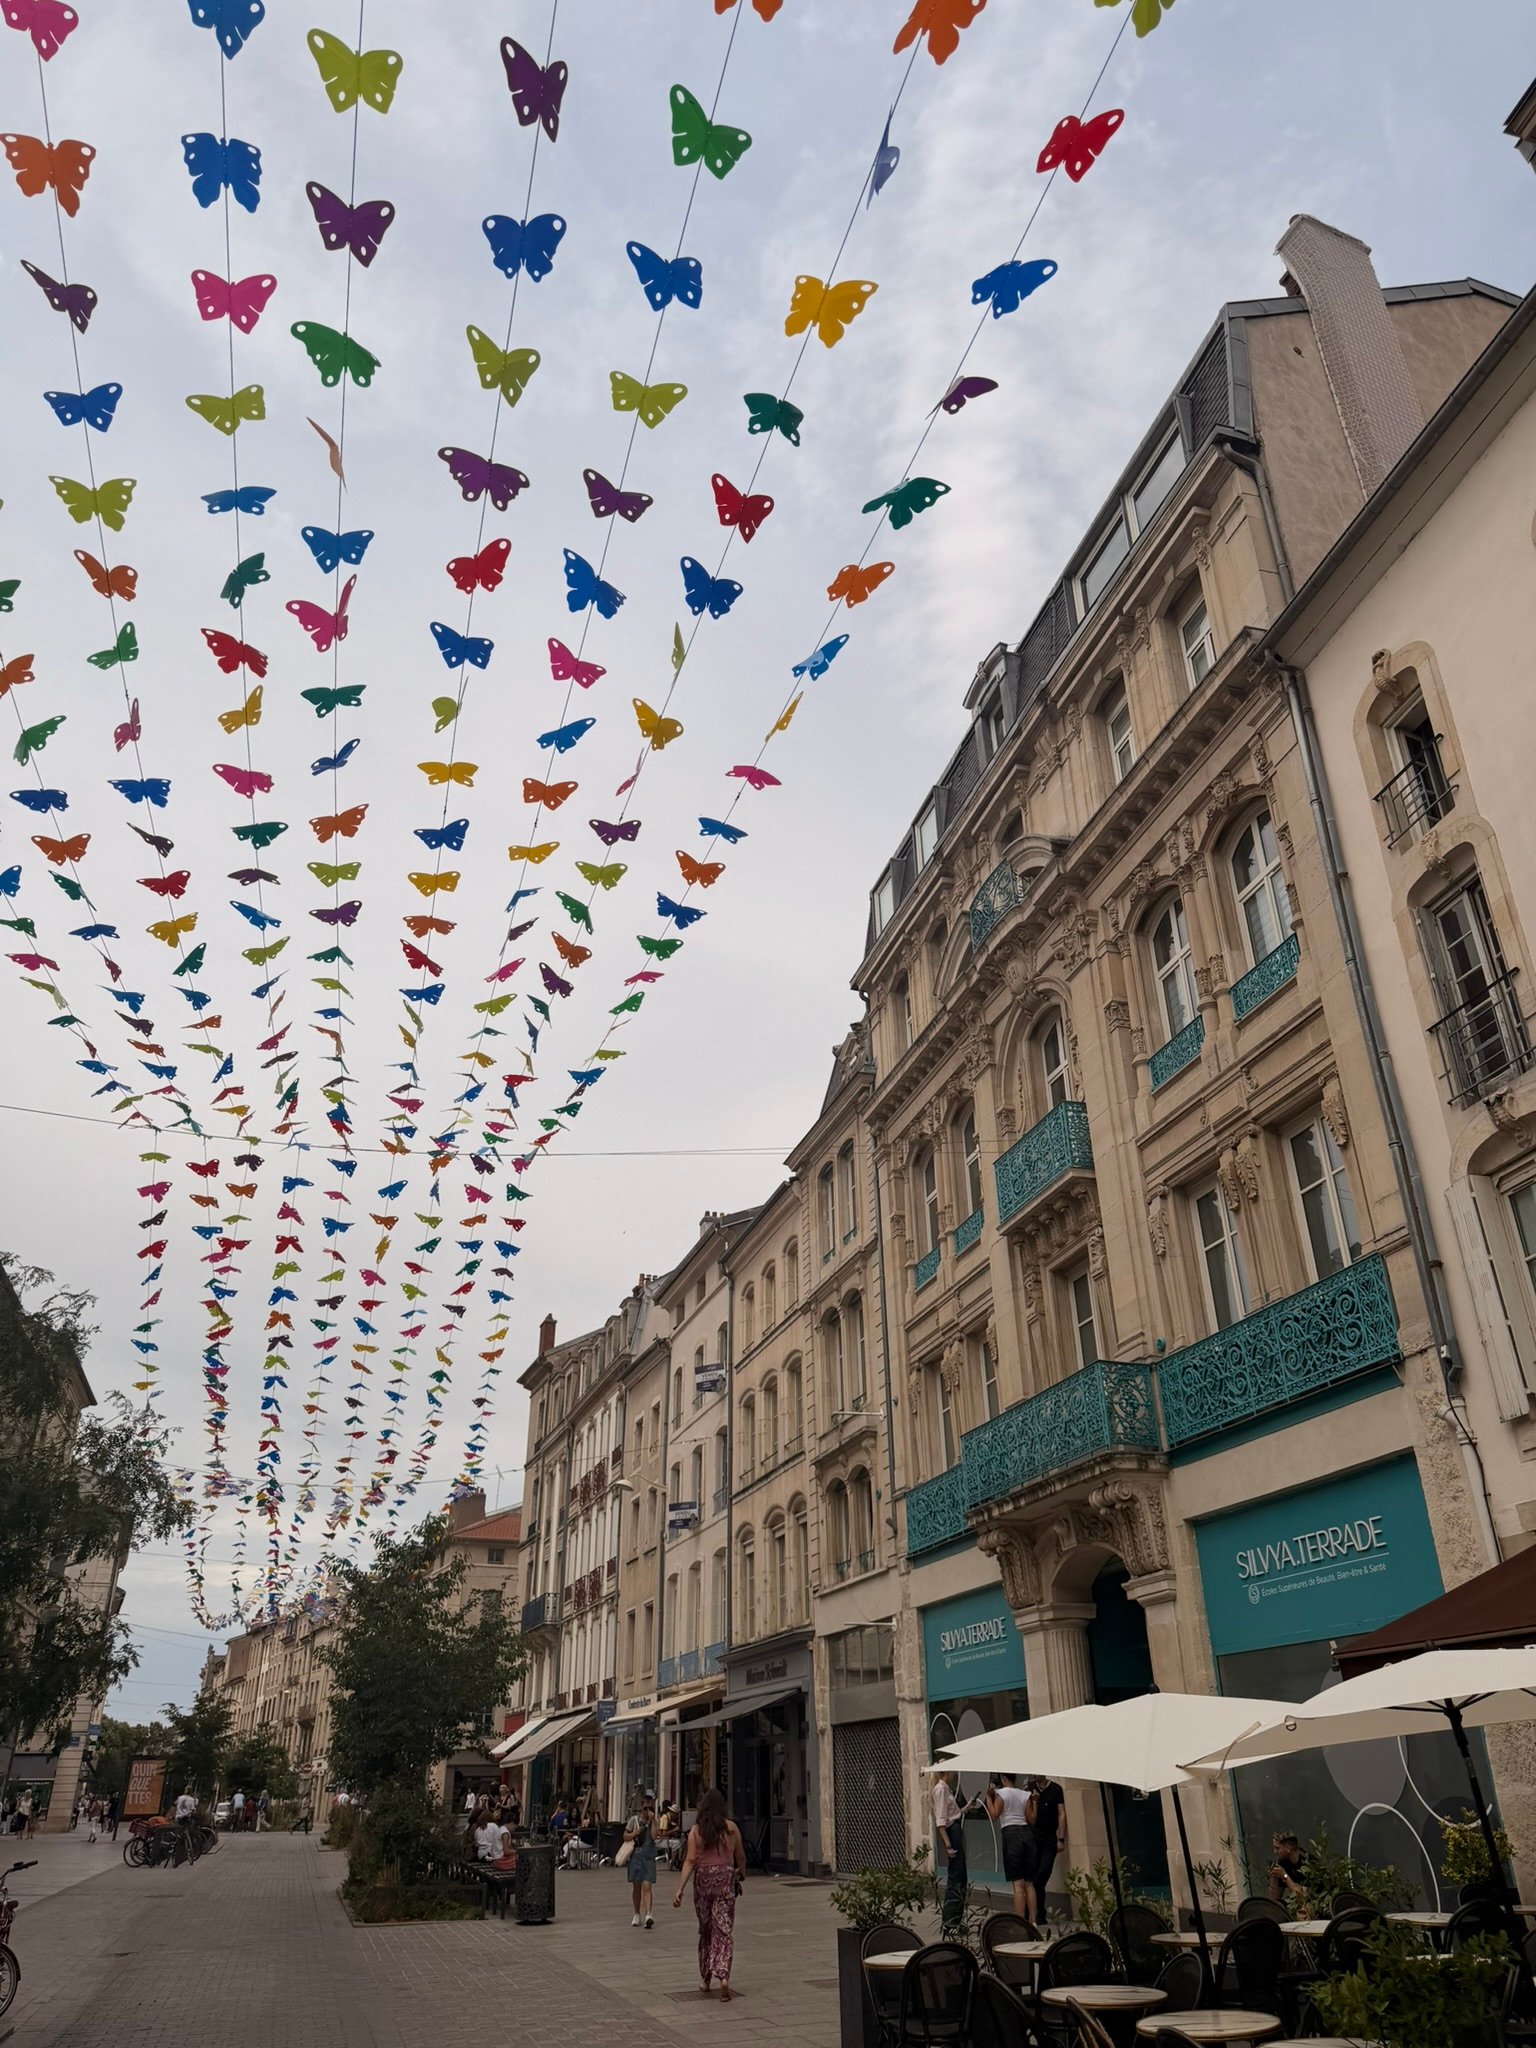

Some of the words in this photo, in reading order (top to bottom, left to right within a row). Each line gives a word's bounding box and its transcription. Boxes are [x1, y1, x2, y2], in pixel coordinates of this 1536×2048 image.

[1235, 1515, 1387, 1579] SILVYA.TERRADE
[1308, 1576, 1316, 1585] de
[1369, 1563, 1386, 1573] Santé
[940, 1616, 1007, 1652] SILVYA.TERRADE
